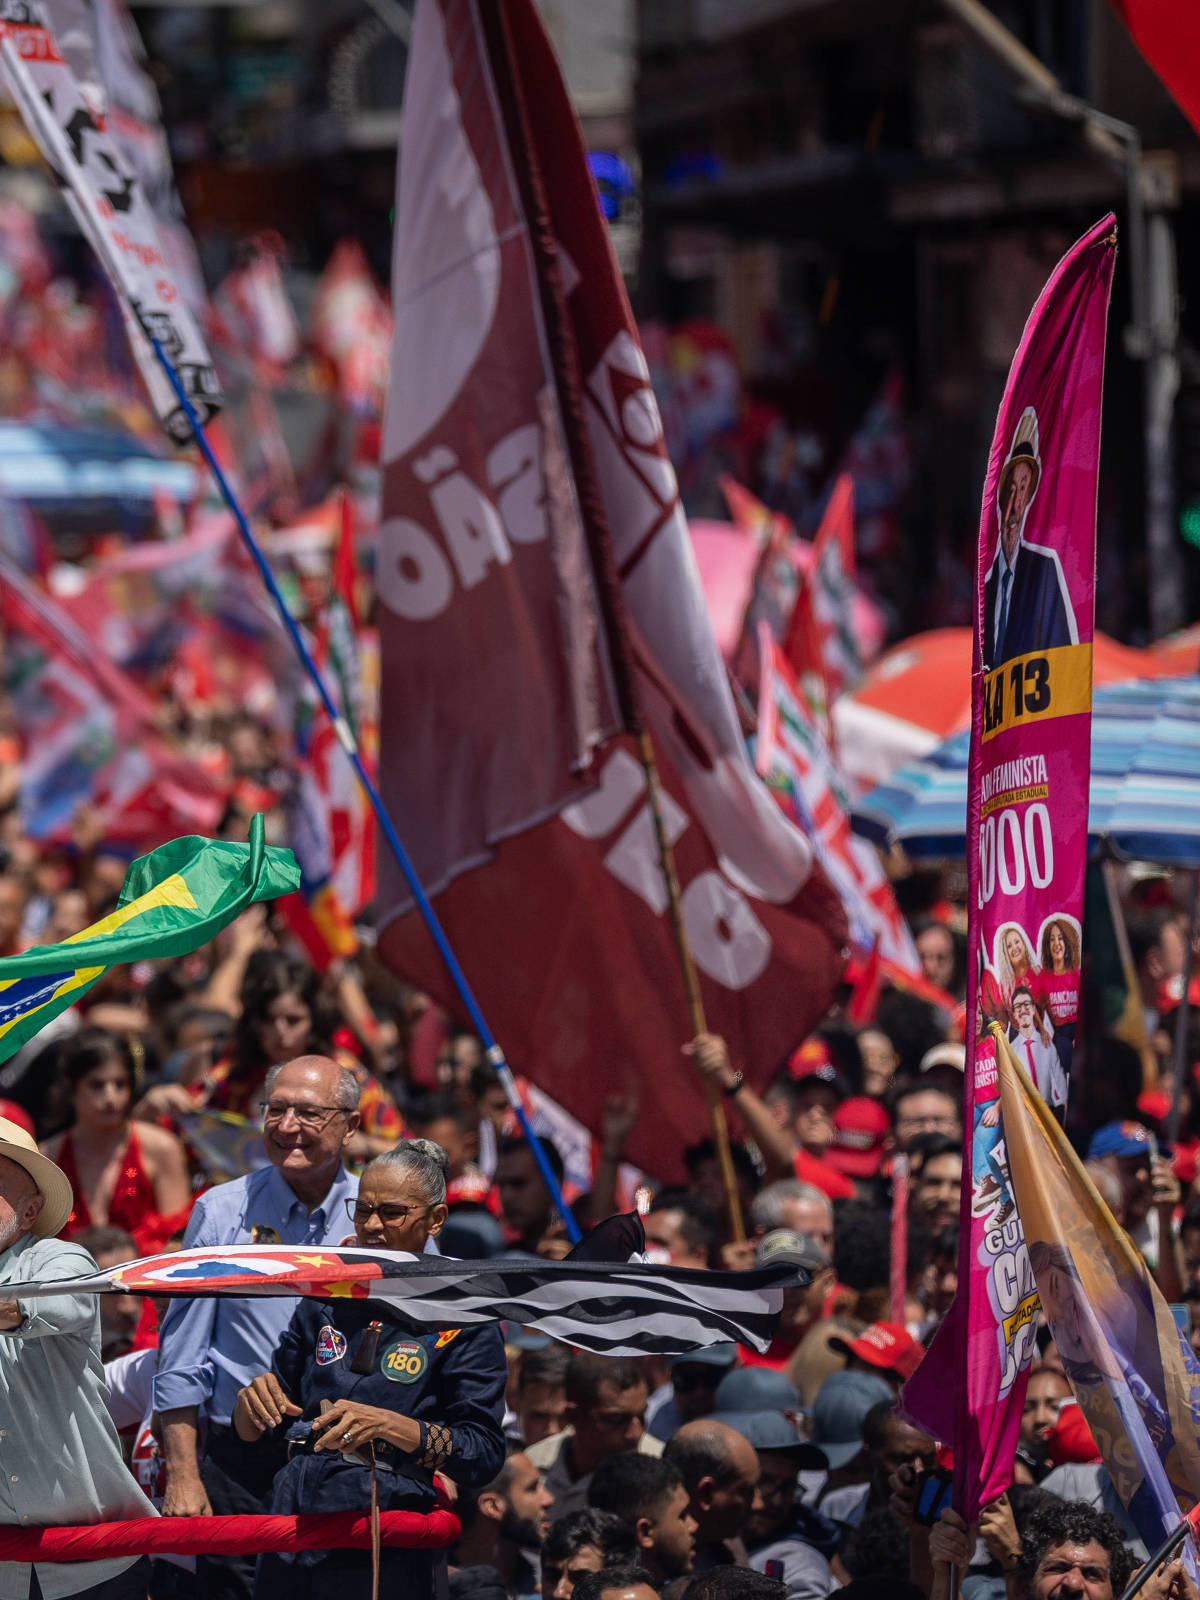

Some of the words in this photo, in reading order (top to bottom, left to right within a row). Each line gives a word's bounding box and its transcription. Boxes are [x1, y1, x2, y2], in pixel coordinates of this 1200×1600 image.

[1011, 658, 1050, 717] 13
[1016, 787, 1047, 801] ESTADUAL
[387, 1352, 421, 1375] 180
